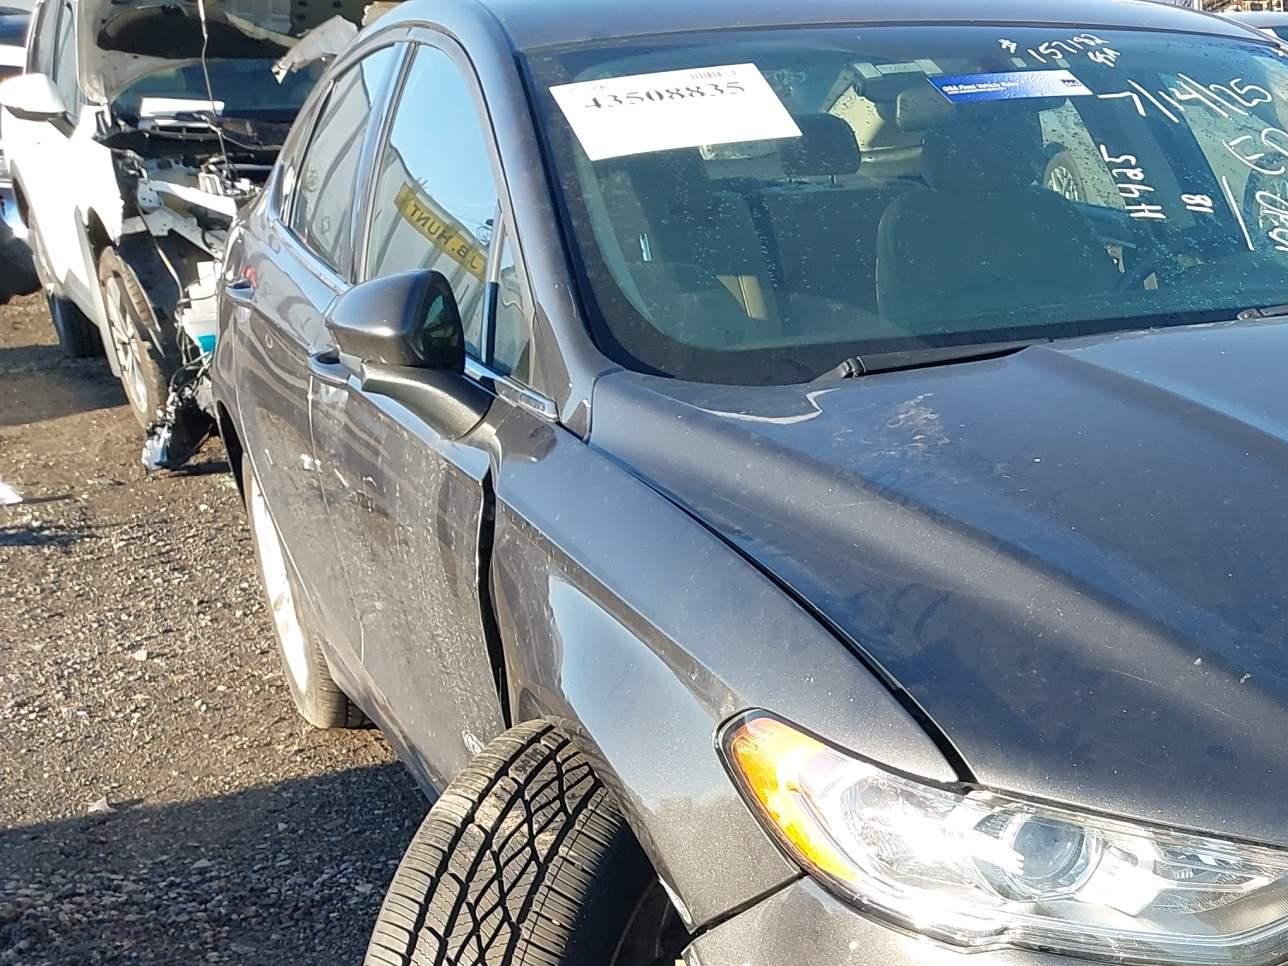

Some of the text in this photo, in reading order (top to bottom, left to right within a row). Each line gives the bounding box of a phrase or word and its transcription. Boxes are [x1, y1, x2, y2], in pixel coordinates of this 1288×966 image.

[584, 80, 746, 109] 43508835
[1097, 72, 1273, 124] 7/14/25
[1181, 193, 1214, 214] 18
